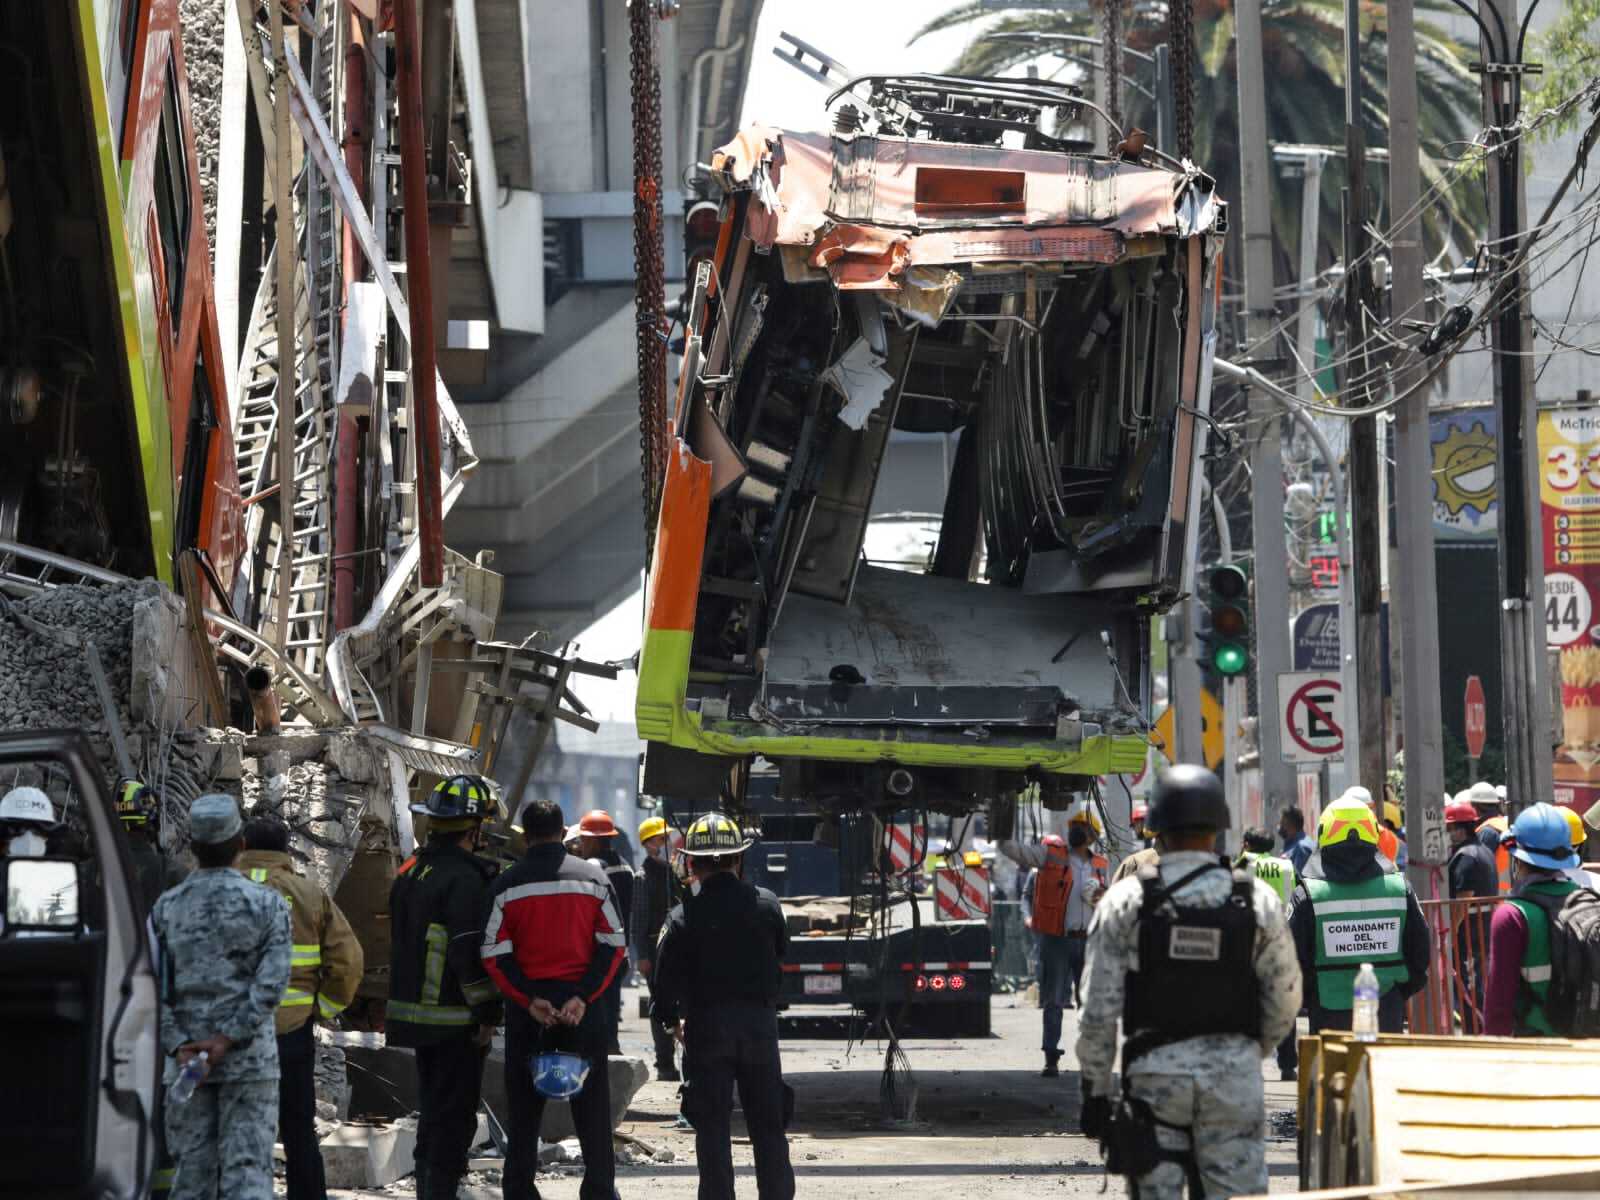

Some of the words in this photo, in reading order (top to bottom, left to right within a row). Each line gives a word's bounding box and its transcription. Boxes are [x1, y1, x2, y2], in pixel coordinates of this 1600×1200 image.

[466, 799, 479, 813] 5
[1328, 921, 1396, 934] COMANDANTE
[1354, 933, 1374, 942] DEL
[1335, 941, 1389, 953] INCIDENTE
